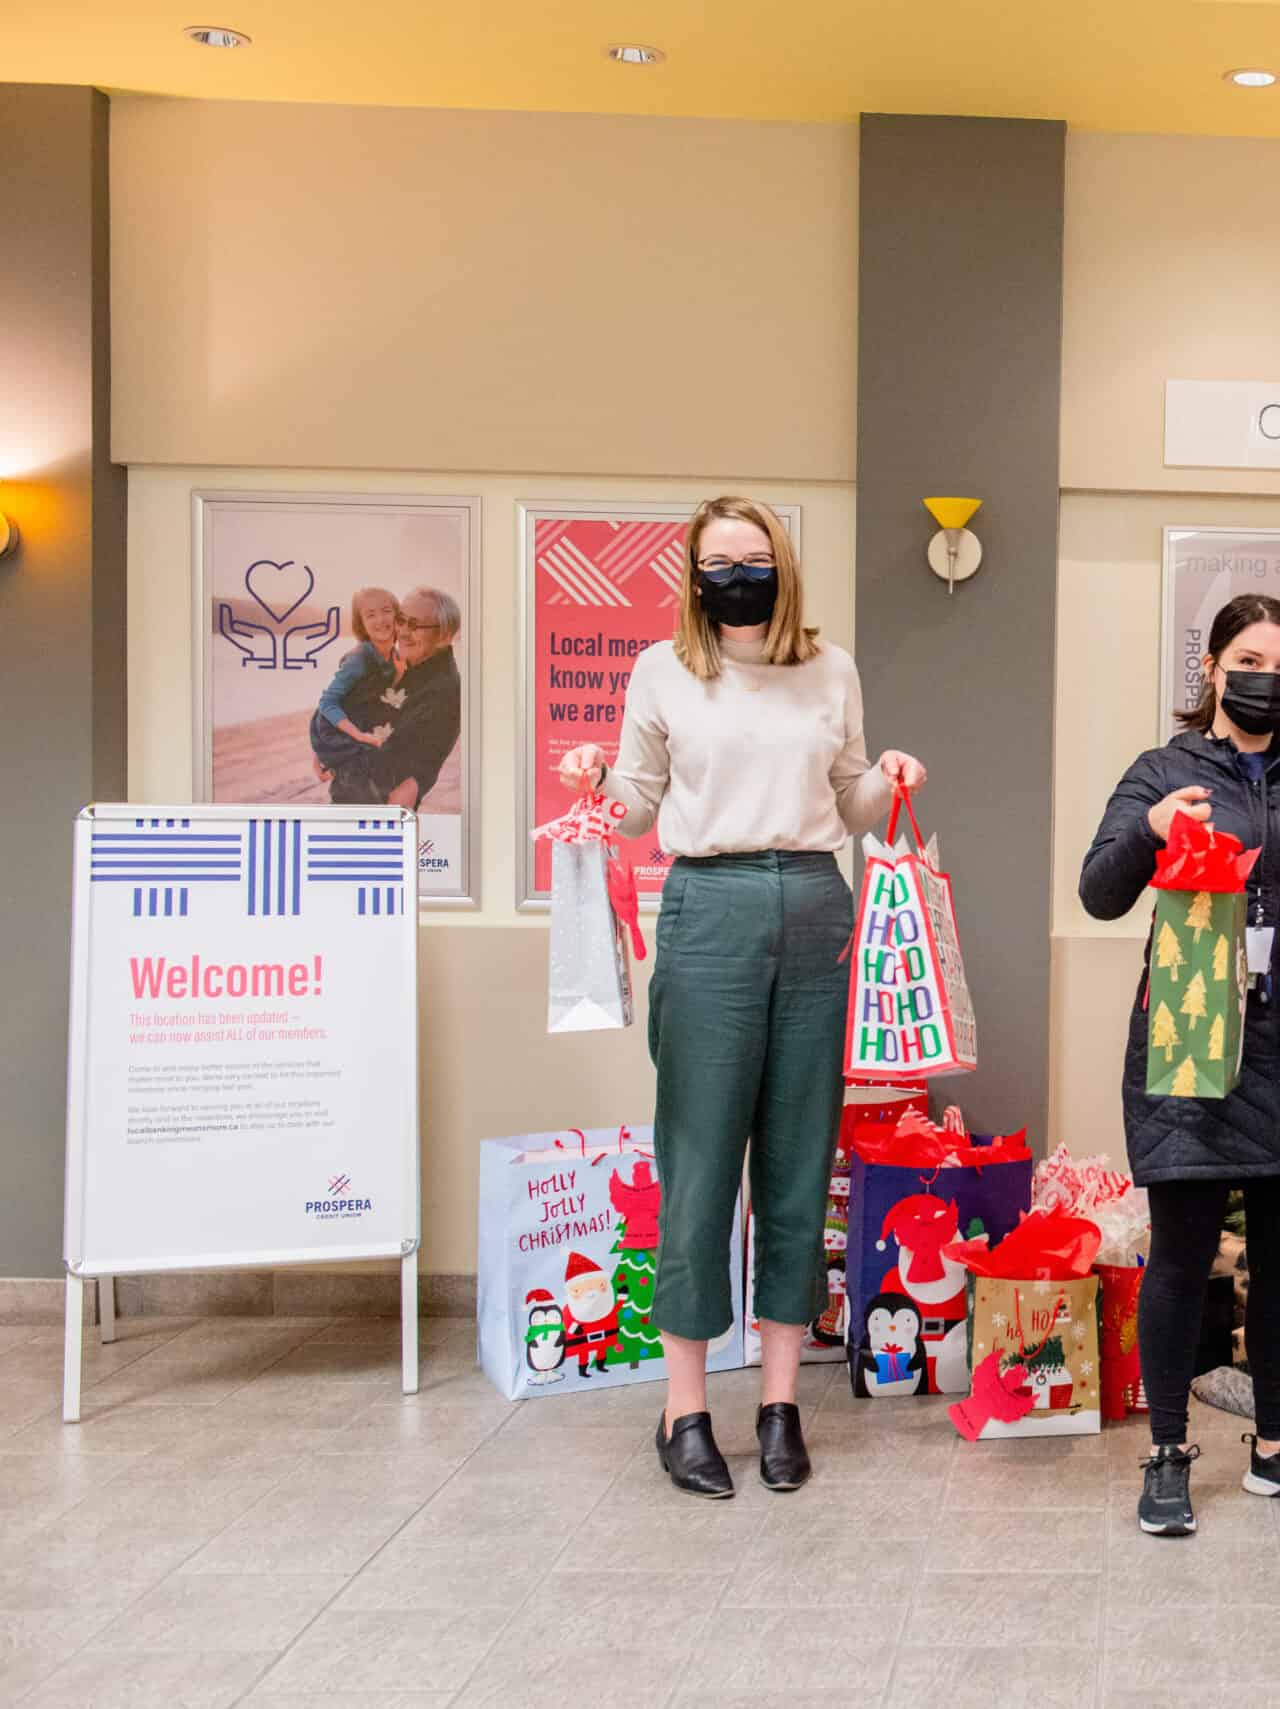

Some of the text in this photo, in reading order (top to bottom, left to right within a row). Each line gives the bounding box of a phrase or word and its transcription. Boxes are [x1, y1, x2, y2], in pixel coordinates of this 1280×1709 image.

[1187, 553, 1267, 577] making
[550, 632, 661, 657] Local mea
[550, 664, 632, 695] know yo
[1184, 628, 1201, 709] PROSPE
[550, 704, 578, 721] we
[584, 704, 616, 722] are
[420, 858, 449, 868] SPERA
[633, 866, 670, 875] PROSPE
[129, 955, 323, 1000] Welcome!
[129, 1013, 151, 1026] This
[154, 1013, 196, 1026] location
[169, 1031, 191, 1042] now
[194, 1029, 224, 1042] assist
[226, 1028, 243, 1041] ALL
[258, 1030, 273, 1041] our
[528, 1169, 576, 1201] HOLLY
[305, 1199, 372, 1214] PROSPERA
[539, 1193, 585, 1223] JOLLY
